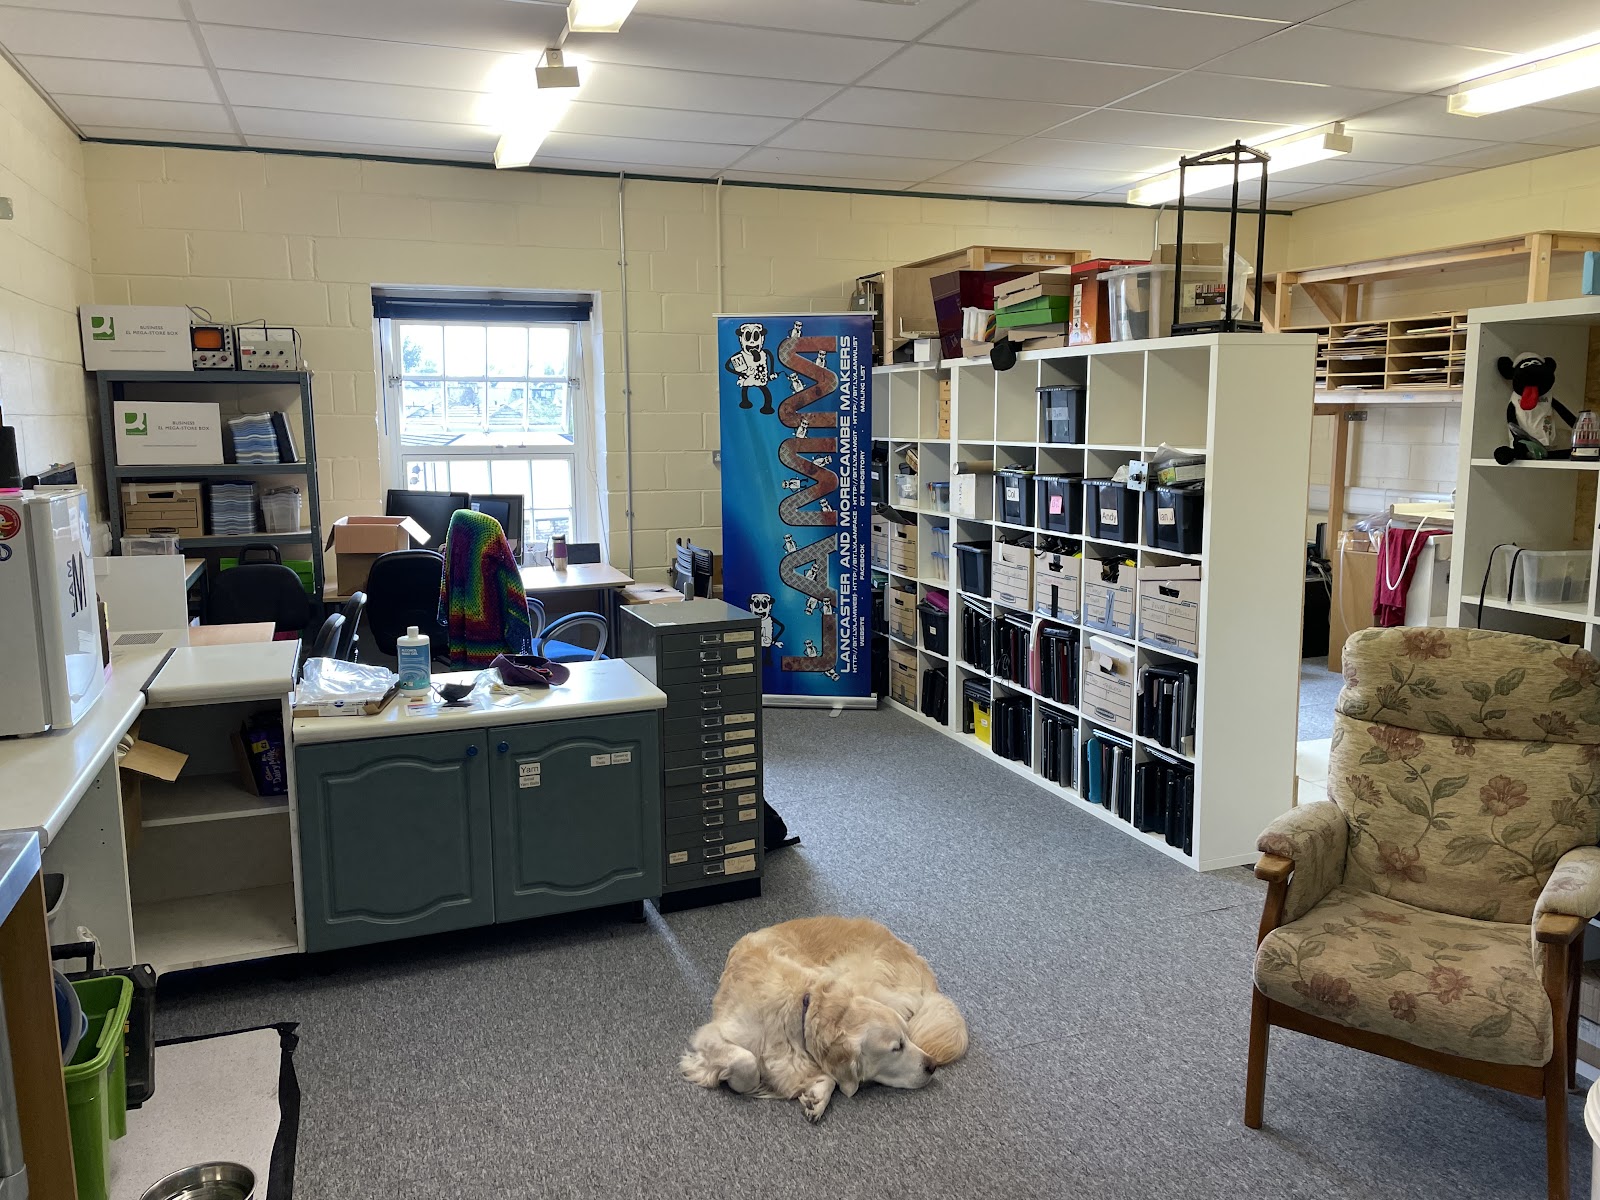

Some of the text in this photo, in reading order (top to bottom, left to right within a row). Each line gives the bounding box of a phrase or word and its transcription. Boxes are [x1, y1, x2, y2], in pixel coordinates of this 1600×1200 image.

[778, 336, 838, 672] LAMM
[840, 336, 850, 673] LANCASTER AND MORECAMBE MAKERS
[1102, 511, 1117, 523] Andy
[272, 765, 281, 784] Dairy
